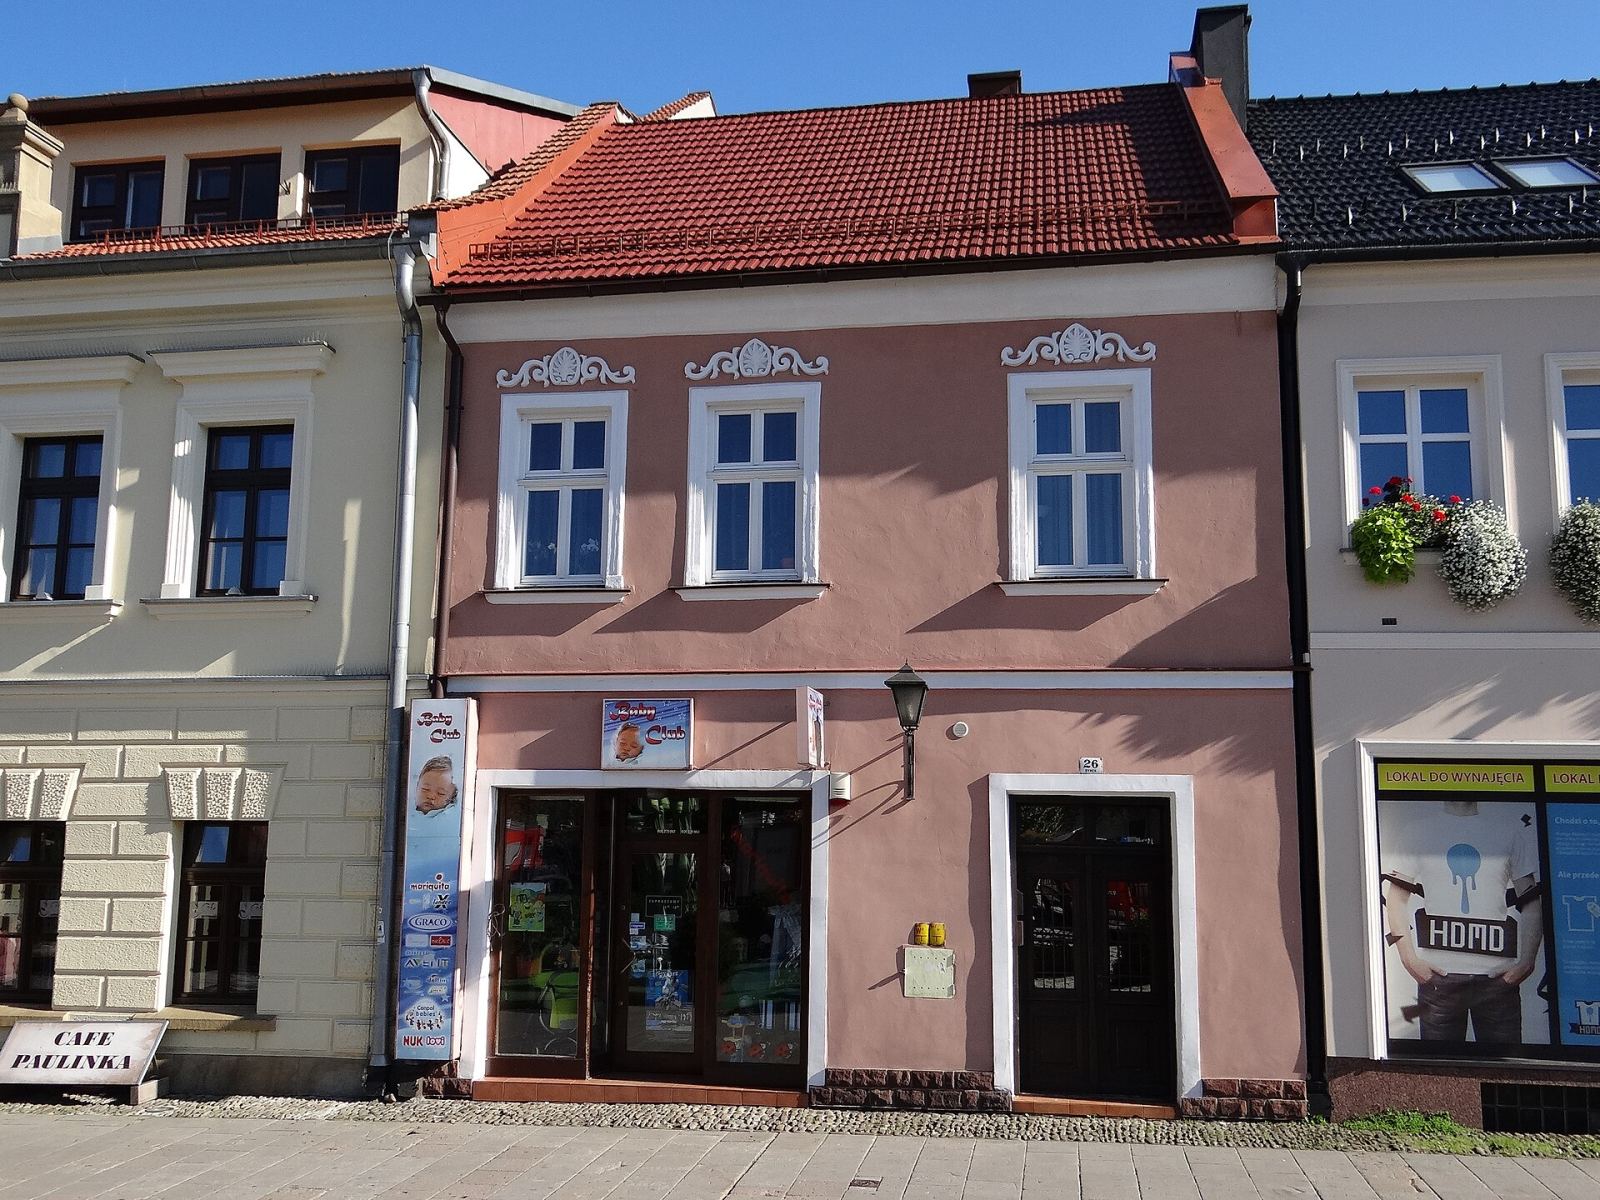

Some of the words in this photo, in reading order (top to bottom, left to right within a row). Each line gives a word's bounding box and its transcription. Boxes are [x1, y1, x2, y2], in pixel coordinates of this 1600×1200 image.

[416, 711, 453, 726] Baby
[608, 702, 657, 720] Baby
[429, 728, 461, 743] Club
[645, 724, 686, 745] Club
[1083, 759, 1099, 769] 26
[1386, 771, 1427, 782] LOKAL
[1429, 772, 1449, 783] DO
[1451, 772, 1525, 786] WYNAJĘCIA
[1553, 773, 1595, 784] LOKAL
[410, 881, 450, 892] mariquita
[415, 918, 448, 927] GRACO
[54, 1031, 114, 1046] CAFE
[403, 1035, 423, 1046] NUK
[426, 1035, 445, 1046] lovi
[10, 1054, 131, 1069] PAULINKA
